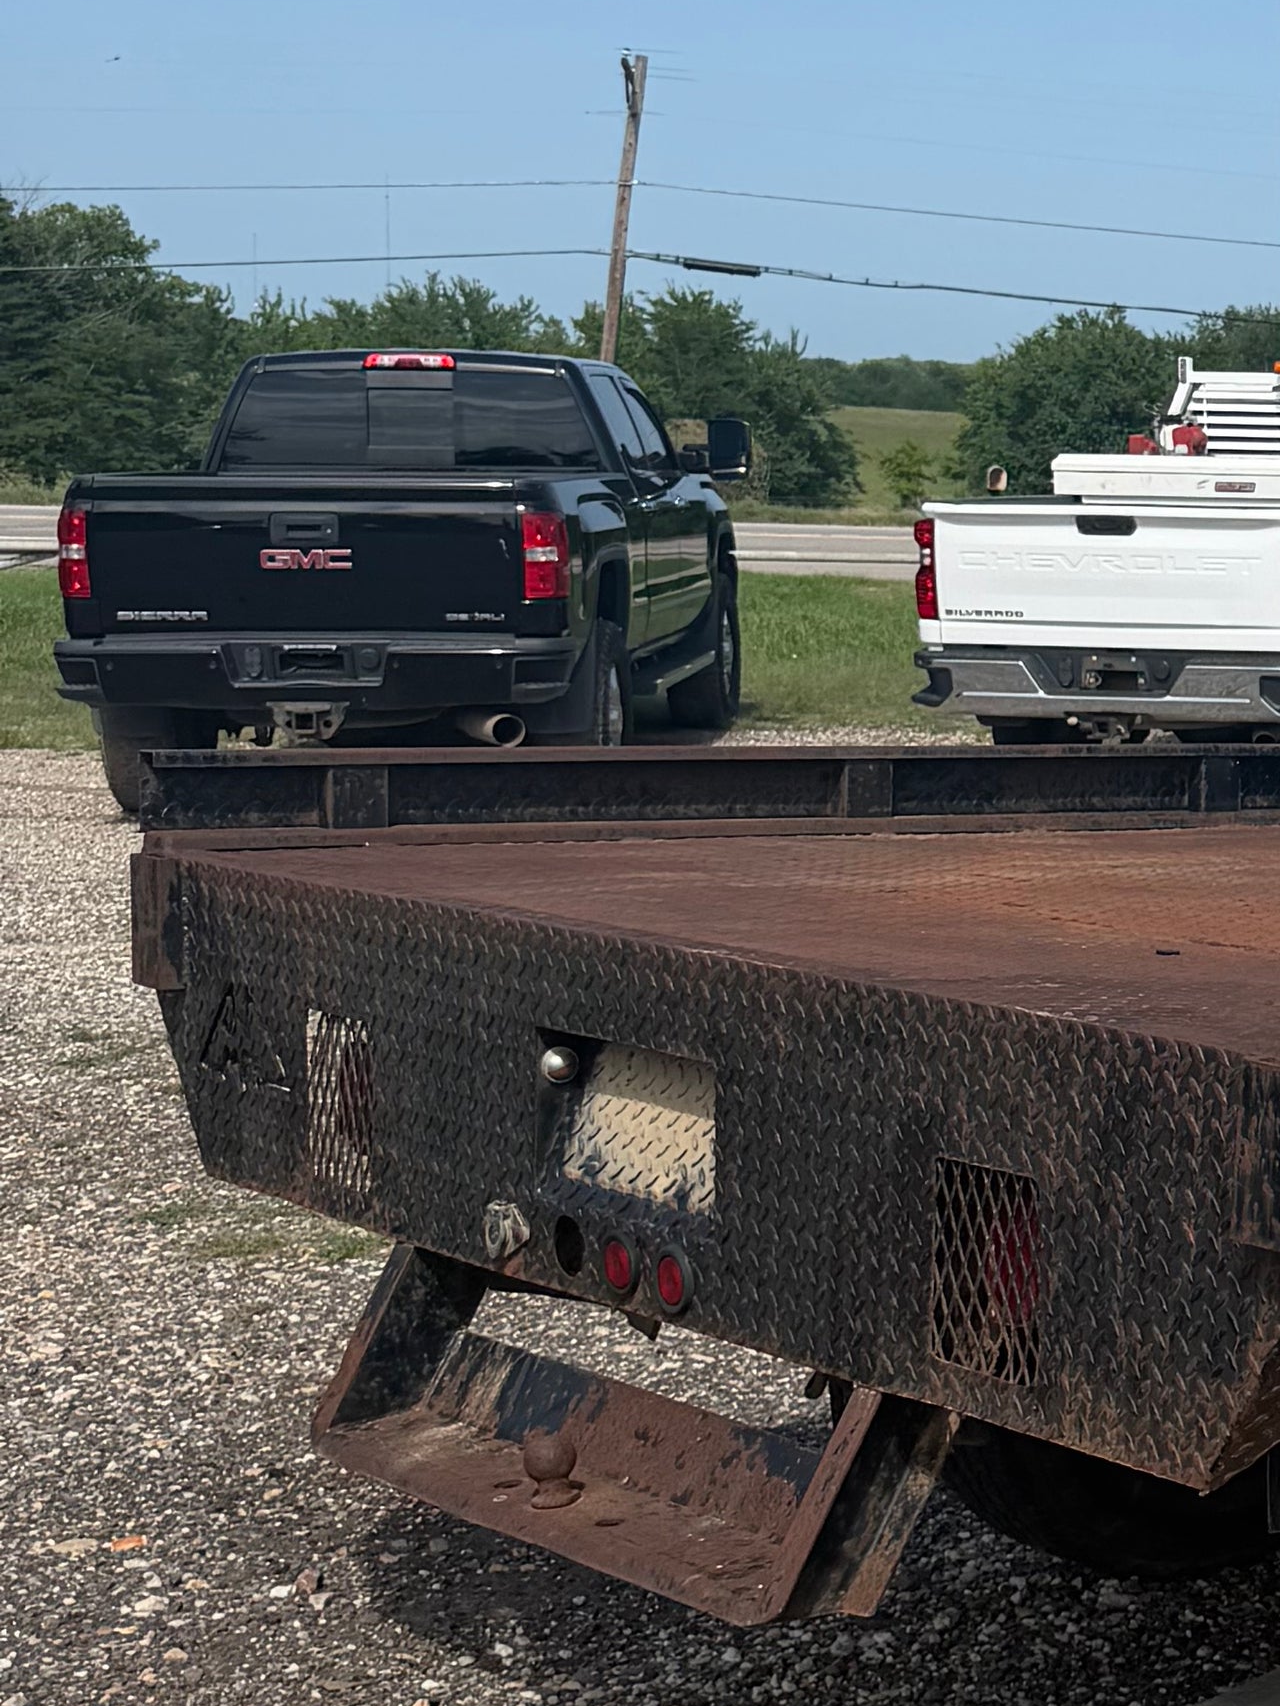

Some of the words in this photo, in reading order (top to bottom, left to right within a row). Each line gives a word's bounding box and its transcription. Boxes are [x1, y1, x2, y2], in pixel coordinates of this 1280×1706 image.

[259, 549, 353, 570] GMC
[957, 550, 1263, 577] CHEVROLET
[116, 611, 208, 622] SIERRA
[944, 609, 1025, 618] SILVERADO
